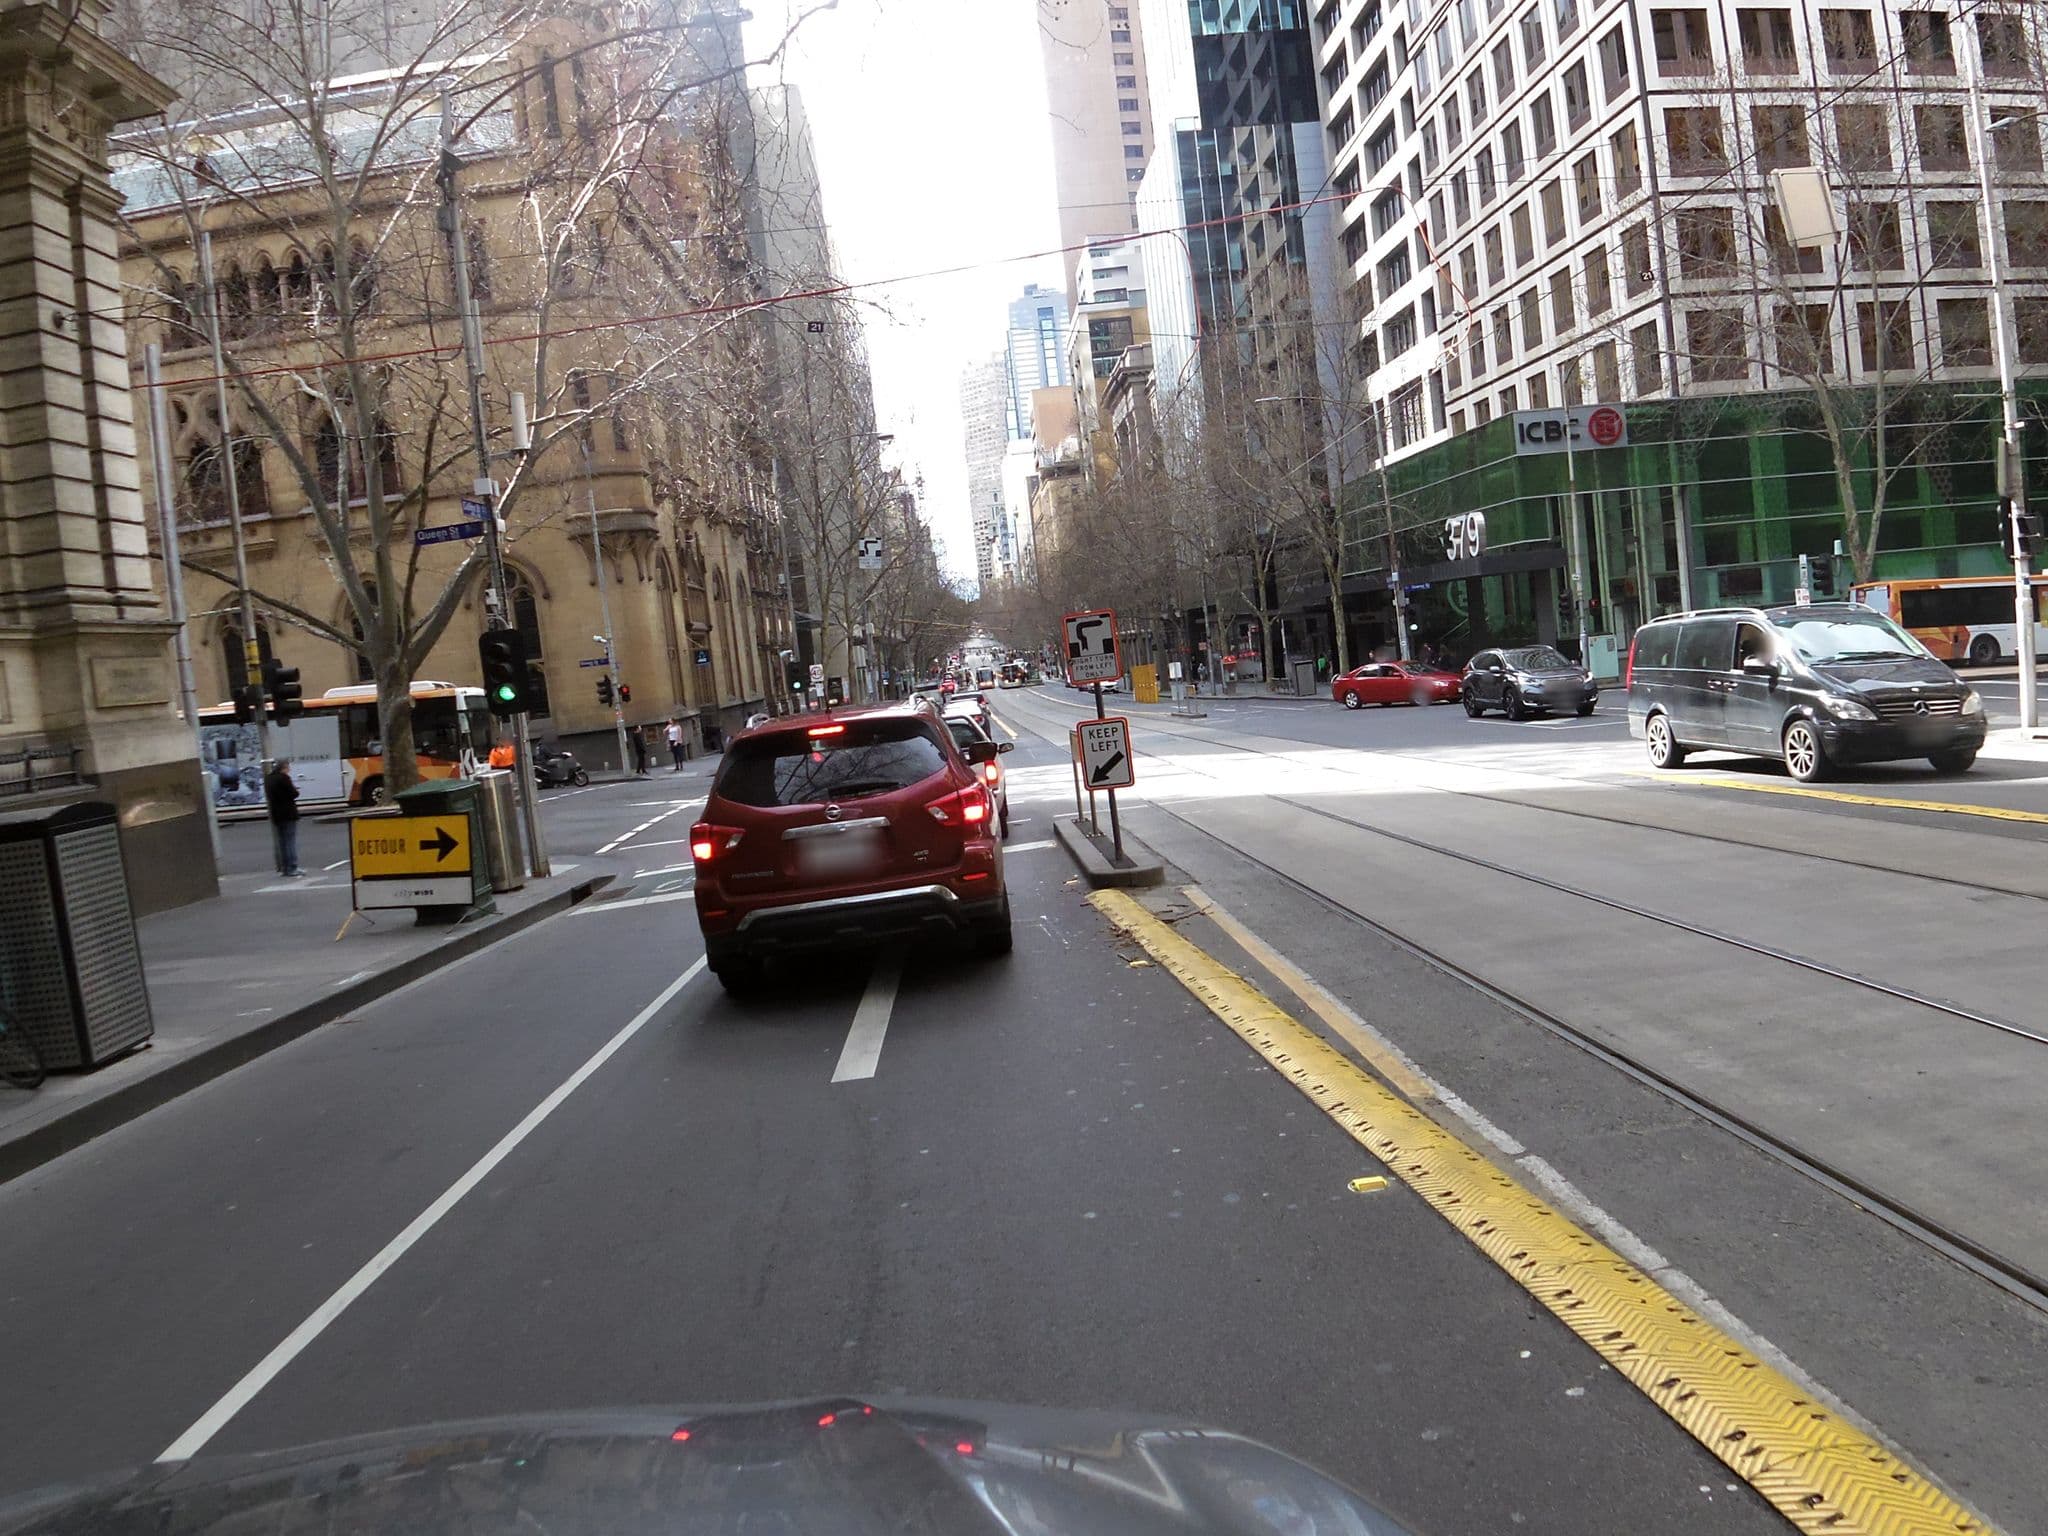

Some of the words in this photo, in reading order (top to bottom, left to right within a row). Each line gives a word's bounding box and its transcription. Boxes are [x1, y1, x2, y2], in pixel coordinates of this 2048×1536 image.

[811, 323, 822, 331] 21
[1518, 418, 1580, 444] ICBC
[417, 530, 448, 541] Queen
[449, 526, 459, 537] St
[1445, 512, 1485, 560] 379
[1089, 727, 1118, 740] KEEP
[1091, 740, 1118, 752] LEFT
[358, 838, 407, 856] DETOUR
